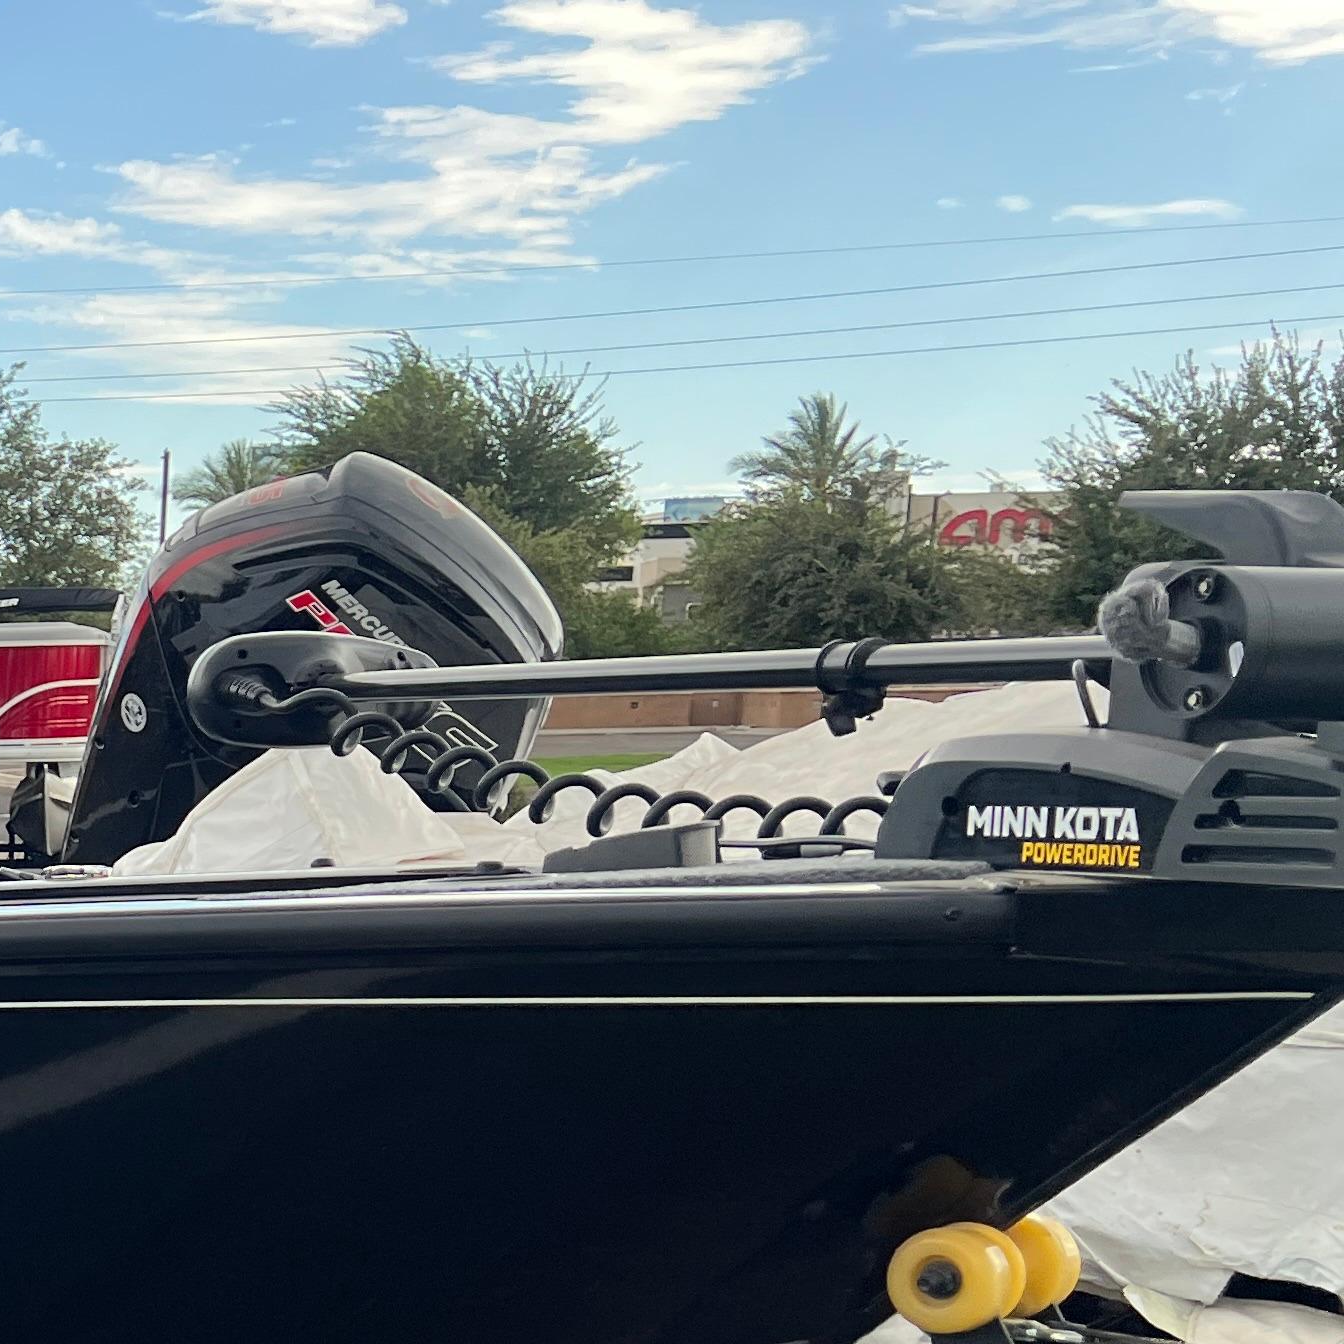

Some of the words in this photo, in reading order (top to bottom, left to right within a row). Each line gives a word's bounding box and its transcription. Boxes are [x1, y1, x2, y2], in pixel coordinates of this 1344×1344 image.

[938, 507, 1053, 545] am
[966, 805, 1049, 838] MINN
[1053, 806, 1140, 842] KOTA
[1021, 841, 1141, 868] POWERDRIVE
